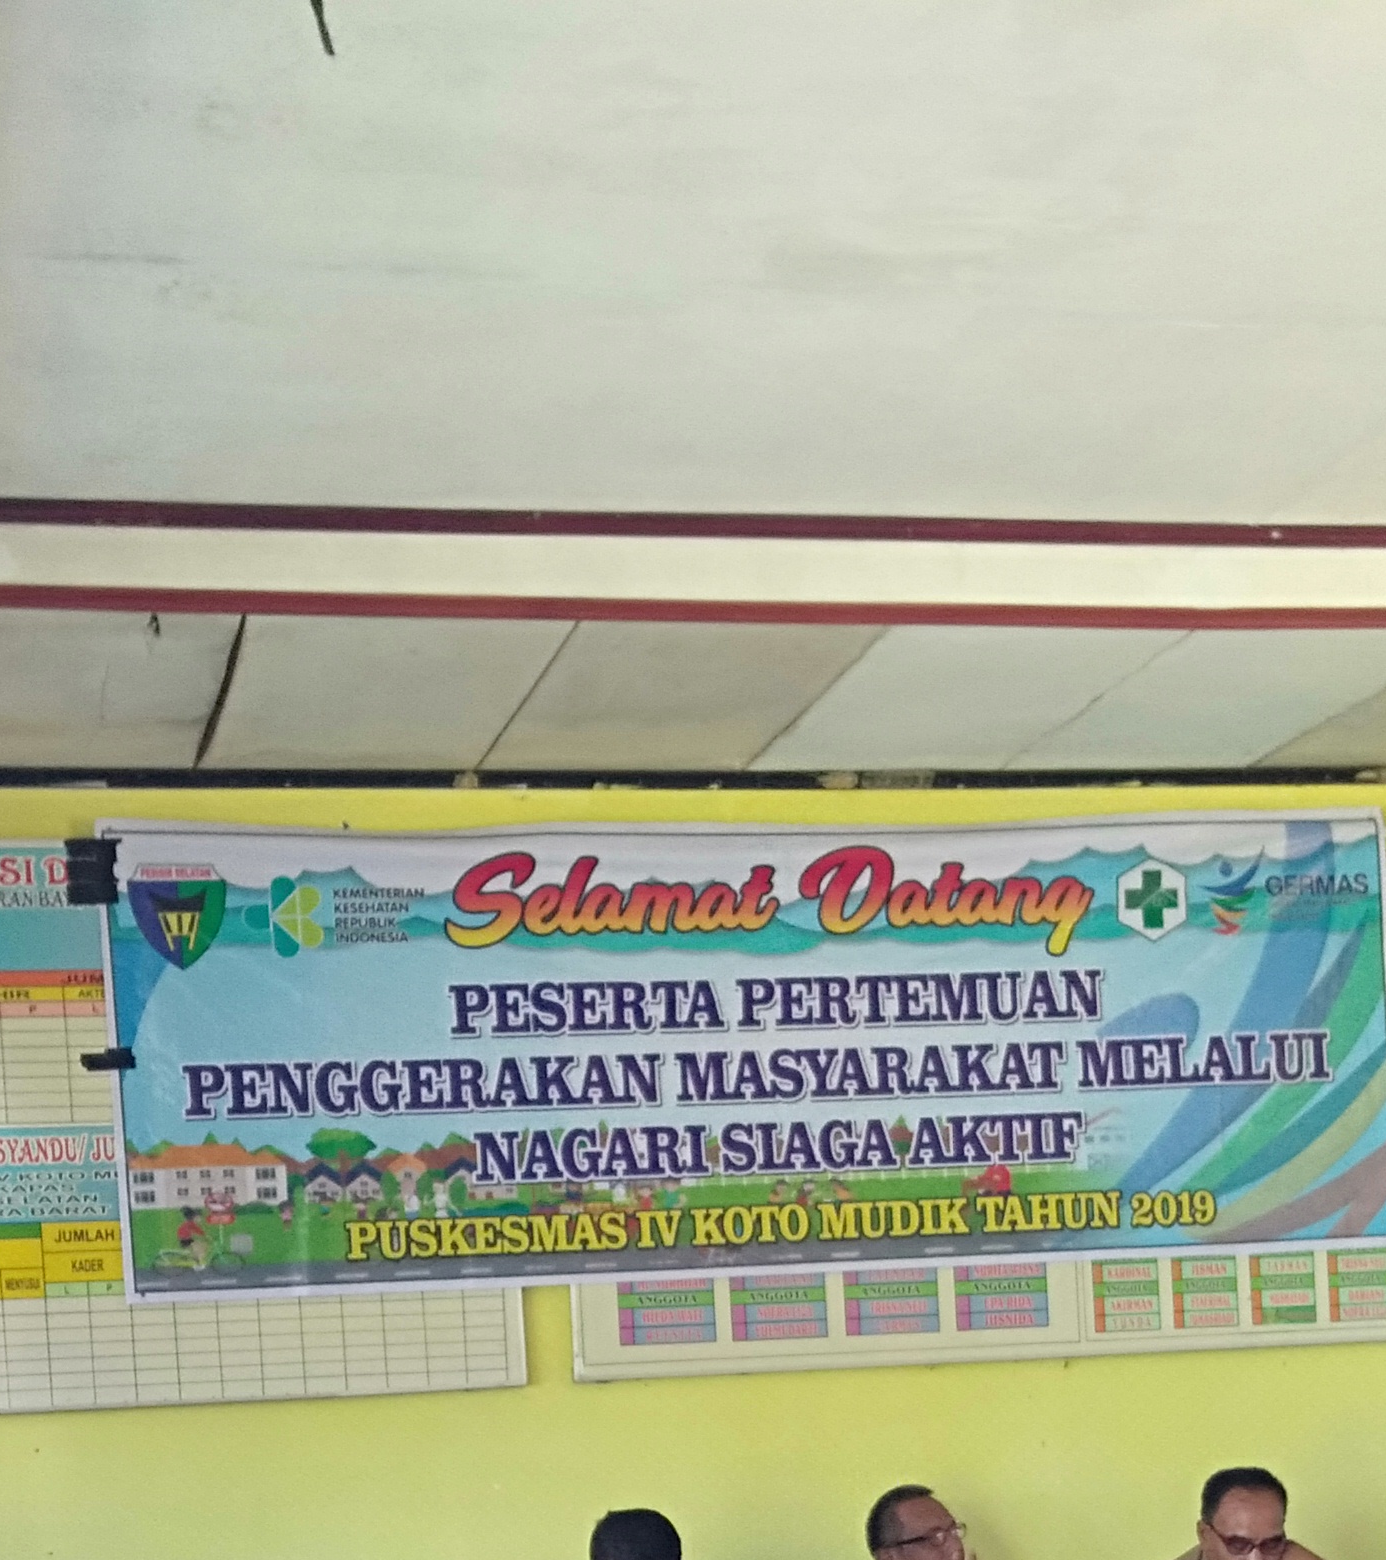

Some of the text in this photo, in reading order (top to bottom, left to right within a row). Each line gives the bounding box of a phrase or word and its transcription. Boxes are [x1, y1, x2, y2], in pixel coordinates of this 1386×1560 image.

[333, 887, 425, 899] KEMENTERIAN
[1264, 872, 1369, 896] GERMAS
[334, 902, 410, 914] KESEHATAN
[445, 845, 1093, 956] Selamat Datang
[334, 917, 397, 928] REPUBLIK
[336, 931, 409, 943] INDONESIA
[448, 968, 1102, 1036] PESERTA PERTEMUAN
[183, 1031, 1334, 1118] PENGGERAKAN MASYARAKAT MELALUI
[474, 1111, 1085, 1184] NAGARI SIAGA AKTIF
[346, 1190, 1216, 1260] PUSKESMAS IV KOTO MUDIK TAHUN 2019
[54, 1229, 115, 1243] JUMLAH
[71, 1259, 104, 1273] KADER
